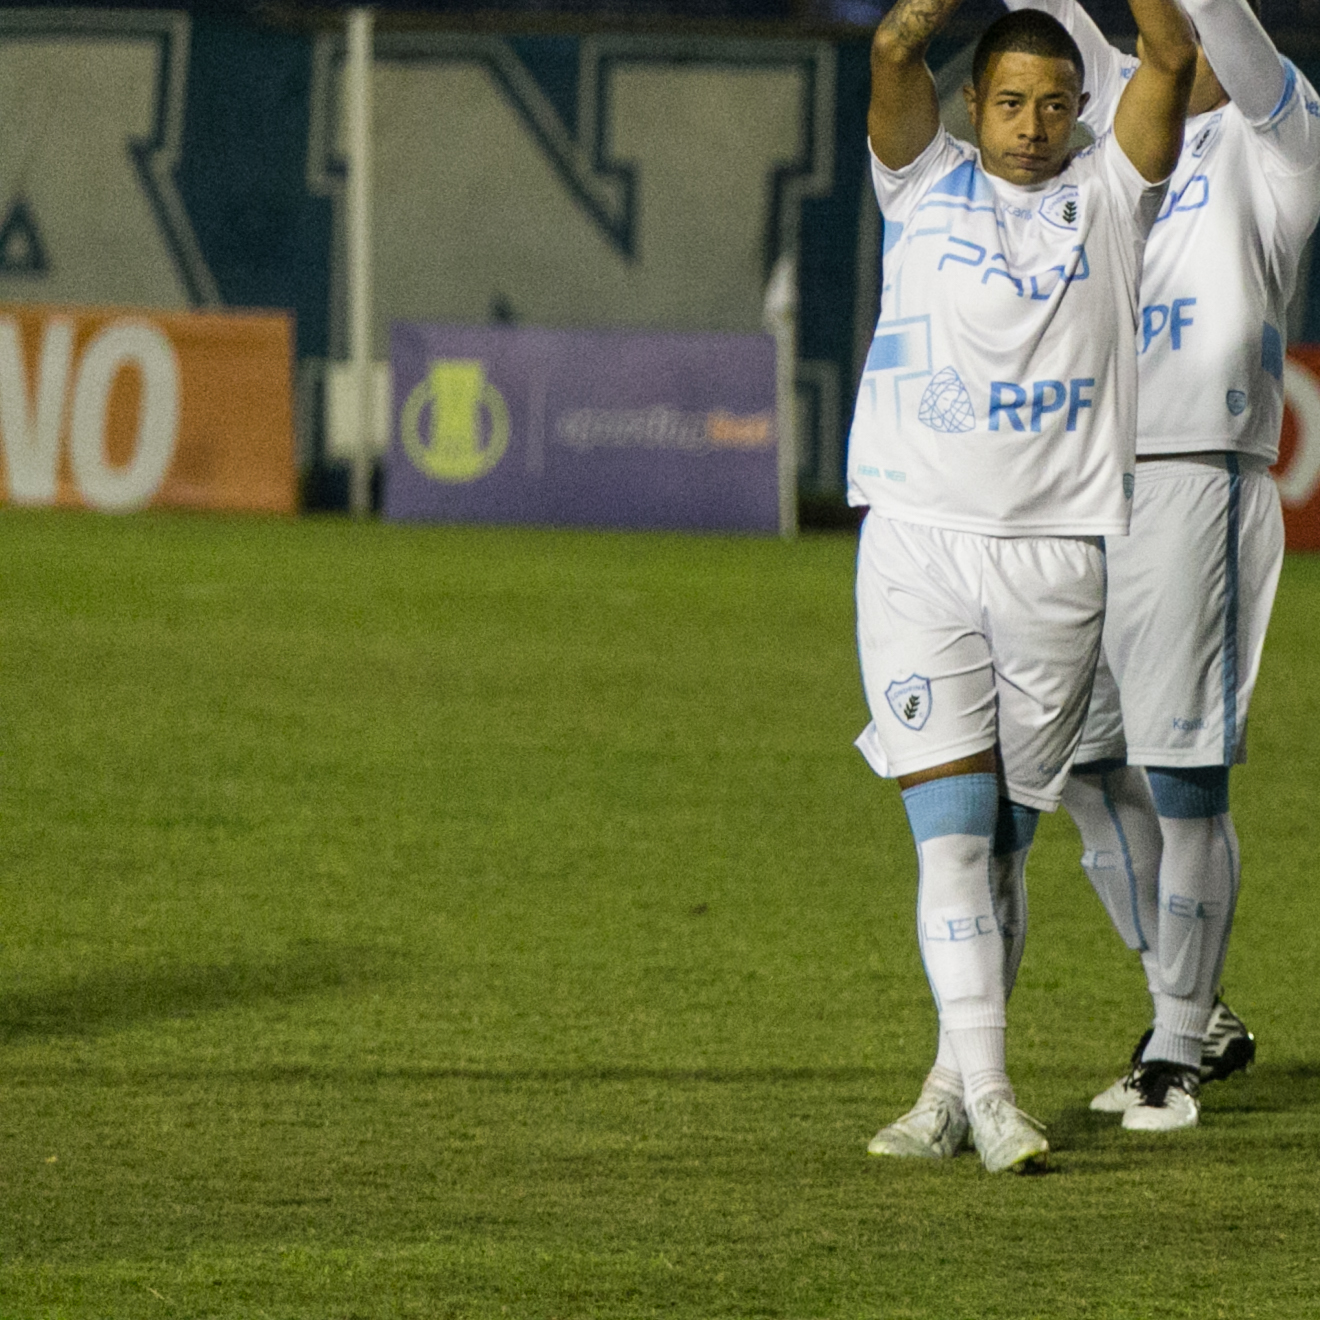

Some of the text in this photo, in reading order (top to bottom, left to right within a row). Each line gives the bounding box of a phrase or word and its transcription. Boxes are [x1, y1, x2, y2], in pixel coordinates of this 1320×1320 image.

[1138, 296, 1197, 356] PF
[987, 377, 1096, 433] RPF
[1168, 893, 1220, 920] EC
[923, 914, 992, 943] LEC
